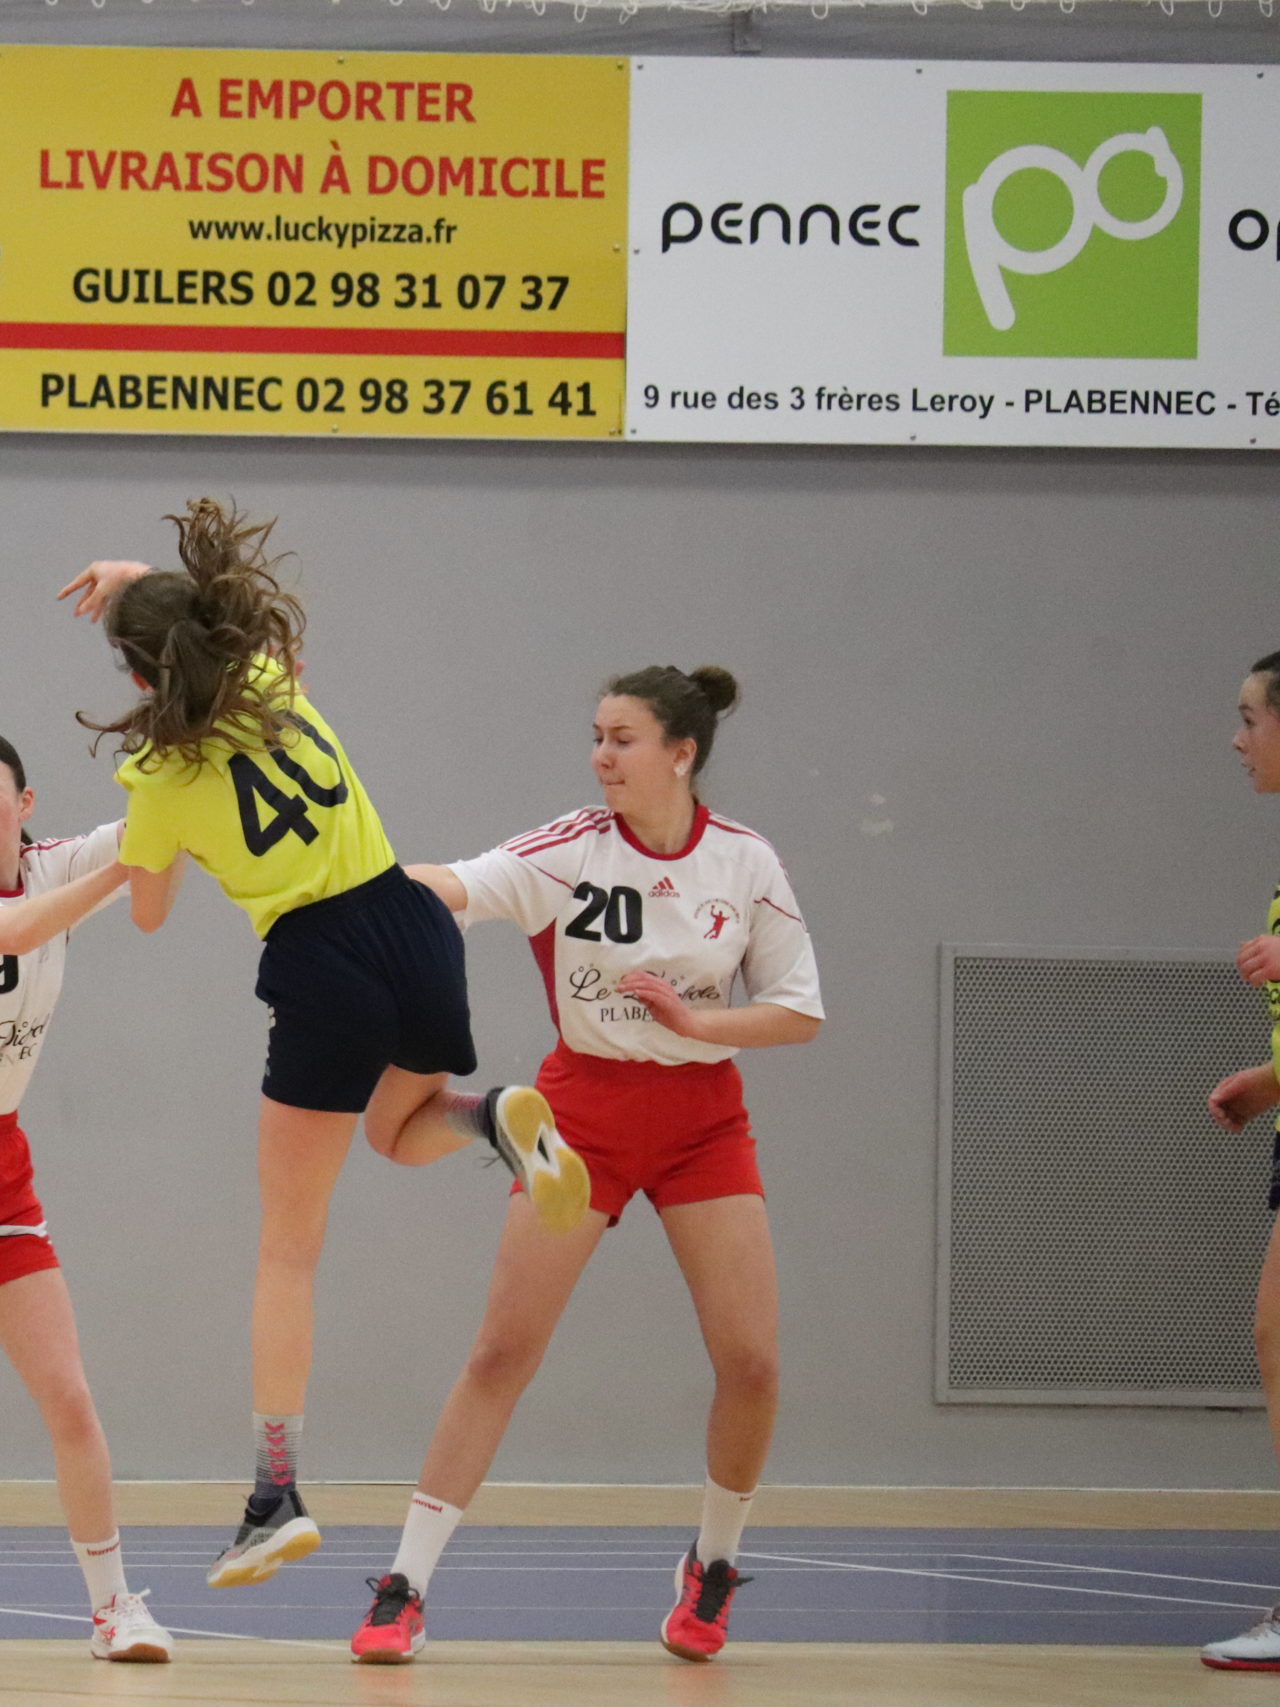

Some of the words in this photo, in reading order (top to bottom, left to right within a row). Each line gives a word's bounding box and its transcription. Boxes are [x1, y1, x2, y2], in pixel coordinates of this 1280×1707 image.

[171, 78, 203, 118] A
[220, 79, 476, 123] EMPORTER
[40, 150, 304, 194] LIVRAISON
[320, 141, 351, 194] À
[368, 156, 606, 199] DOMICILE
[189, 215, 458, 249] www.luckypizza.fr
[1228, 209, 1280, 262] o
[73, 268, 254, 306] GUILERS
[267, 271, 317, 307] 02
[330, 272, 381, 308] 98
[394, 273, 442, 309] 31
[457, 274, 507, 310] 07
[520, 275, 570, 311] 37
[42, 374, 283, 412] PLABENNEC
[296, 377, 346, 413] 02
[359, 378, 409, 414] 98
[422, 379, 472, 415] 37
[485, 380, 534, 416] 61
[548, 382, 597, 417] 41
[644, 385, 660, 410] 9
[670, 390, 717, 410] rue
[727, 386, 779, 411] des
[790, 387, 806, 411] 3
[815, 387, 901, 412] frères
[911, 388, 995, 420] Leroy
[1024, 389, 1216, 416] PLABENNEC
[227, 708, 349, 857] 40
[565, 881, 643, 944] 20
[570, 968, 611, 1001] Le
[600, 1006, 656, 1023] PLABE
